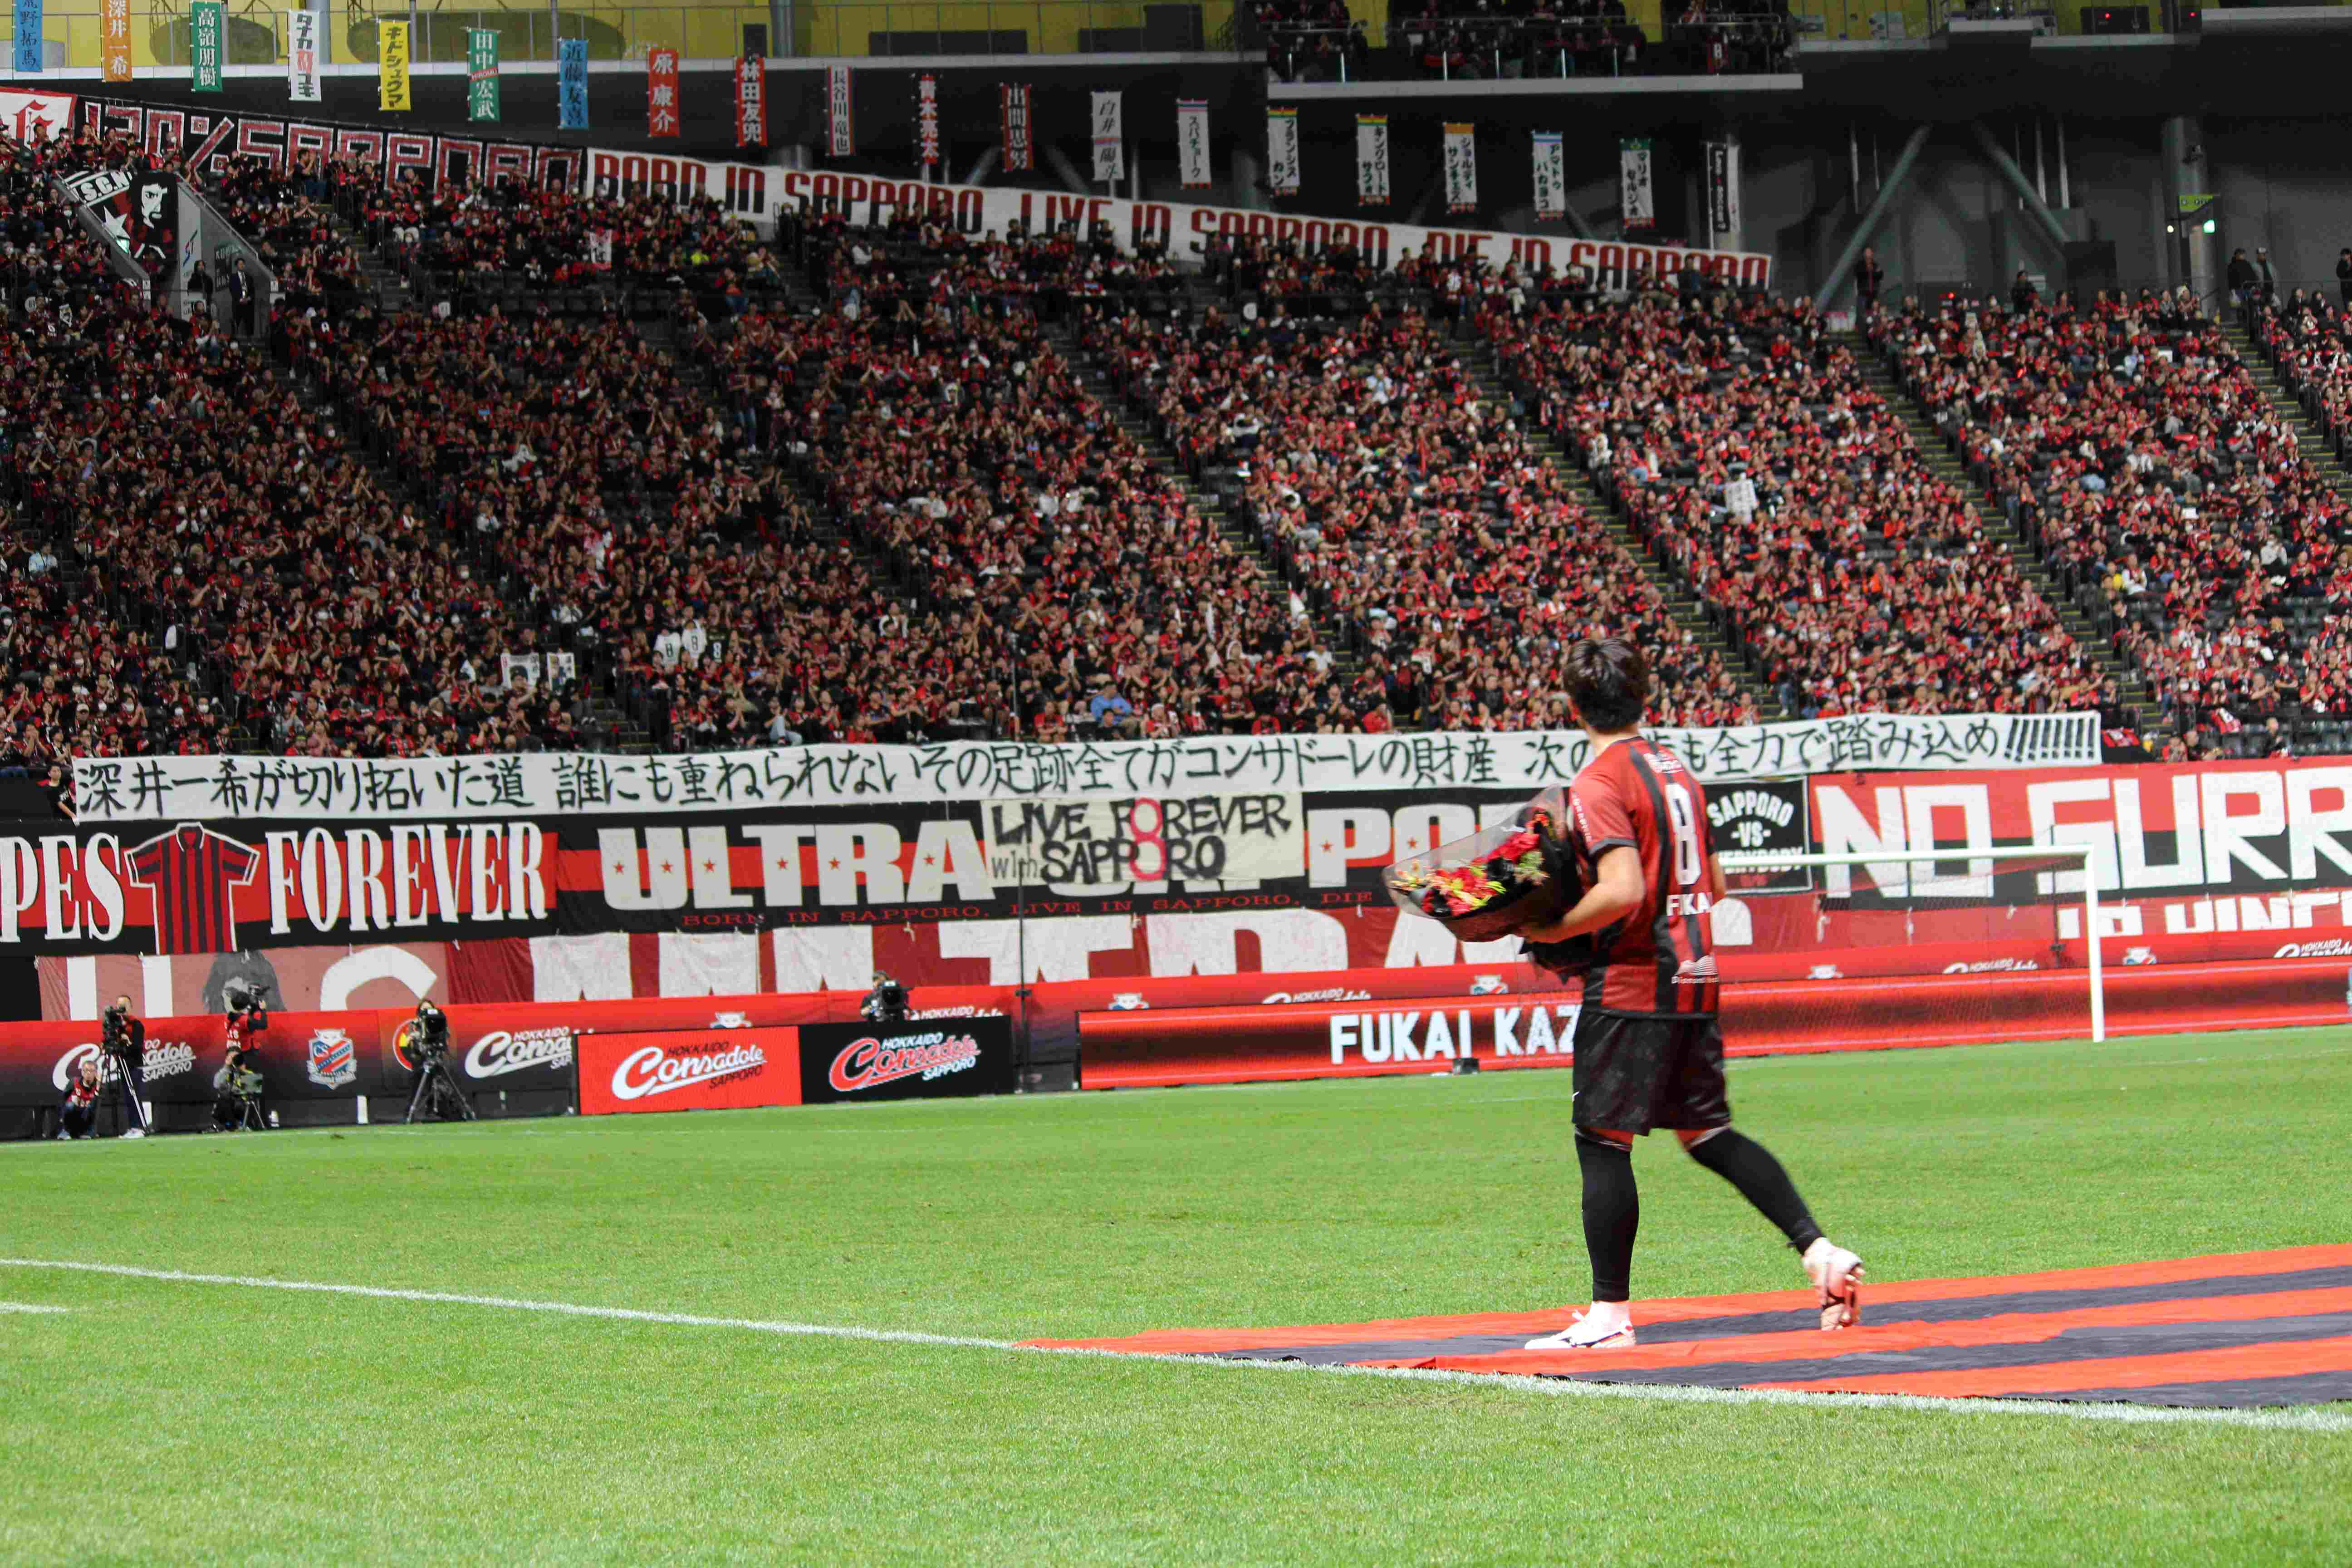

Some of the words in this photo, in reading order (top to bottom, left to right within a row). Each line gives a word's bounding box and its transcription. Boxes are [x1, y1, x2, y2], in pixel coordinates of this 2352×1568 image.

[108, 0, 127, 75] 深井一希
[475, 32, 493, 69] 田中
[652, 52, 673, 74] 原
[77, 758, 533, 817] 深井一希が切り拓いた道
[992, 802, 1091, 845] LIVE
[1706, 789, 1794, 827] SAPPORO
[1664, 783, 1701, 885] 8
[1815, 784, 1994, 899] NO
[265, 822, 547, 935] FOREVER
[597, 820, 995, 910] ULTRA
[683, 913, 764, 926] BORN
[788, 911, 819, 922] IN
[1009, 902, 1082, 915] LIVE
[1101, 900, 1132, 912] IN
[1321, 892, 1372, 904] DIE
[514, 1027, 570, 1041] HOKKAIDO
[668, 1041, 730, 1056] HOKKAIDO
[882, 1033, 943, 1050] HOKKAIDO
[1331, 1010, 1471, 1064] FUKAI
[142, 1060, 192, 1083] SAPPORO
[612, 1044, 768, 1100] Consadole
[708, 1065, 763, 1089] SAPPORO
[829, 1034, 980, 1091] Consadole
[922, 1056, 976, 1082] SAPPORO
